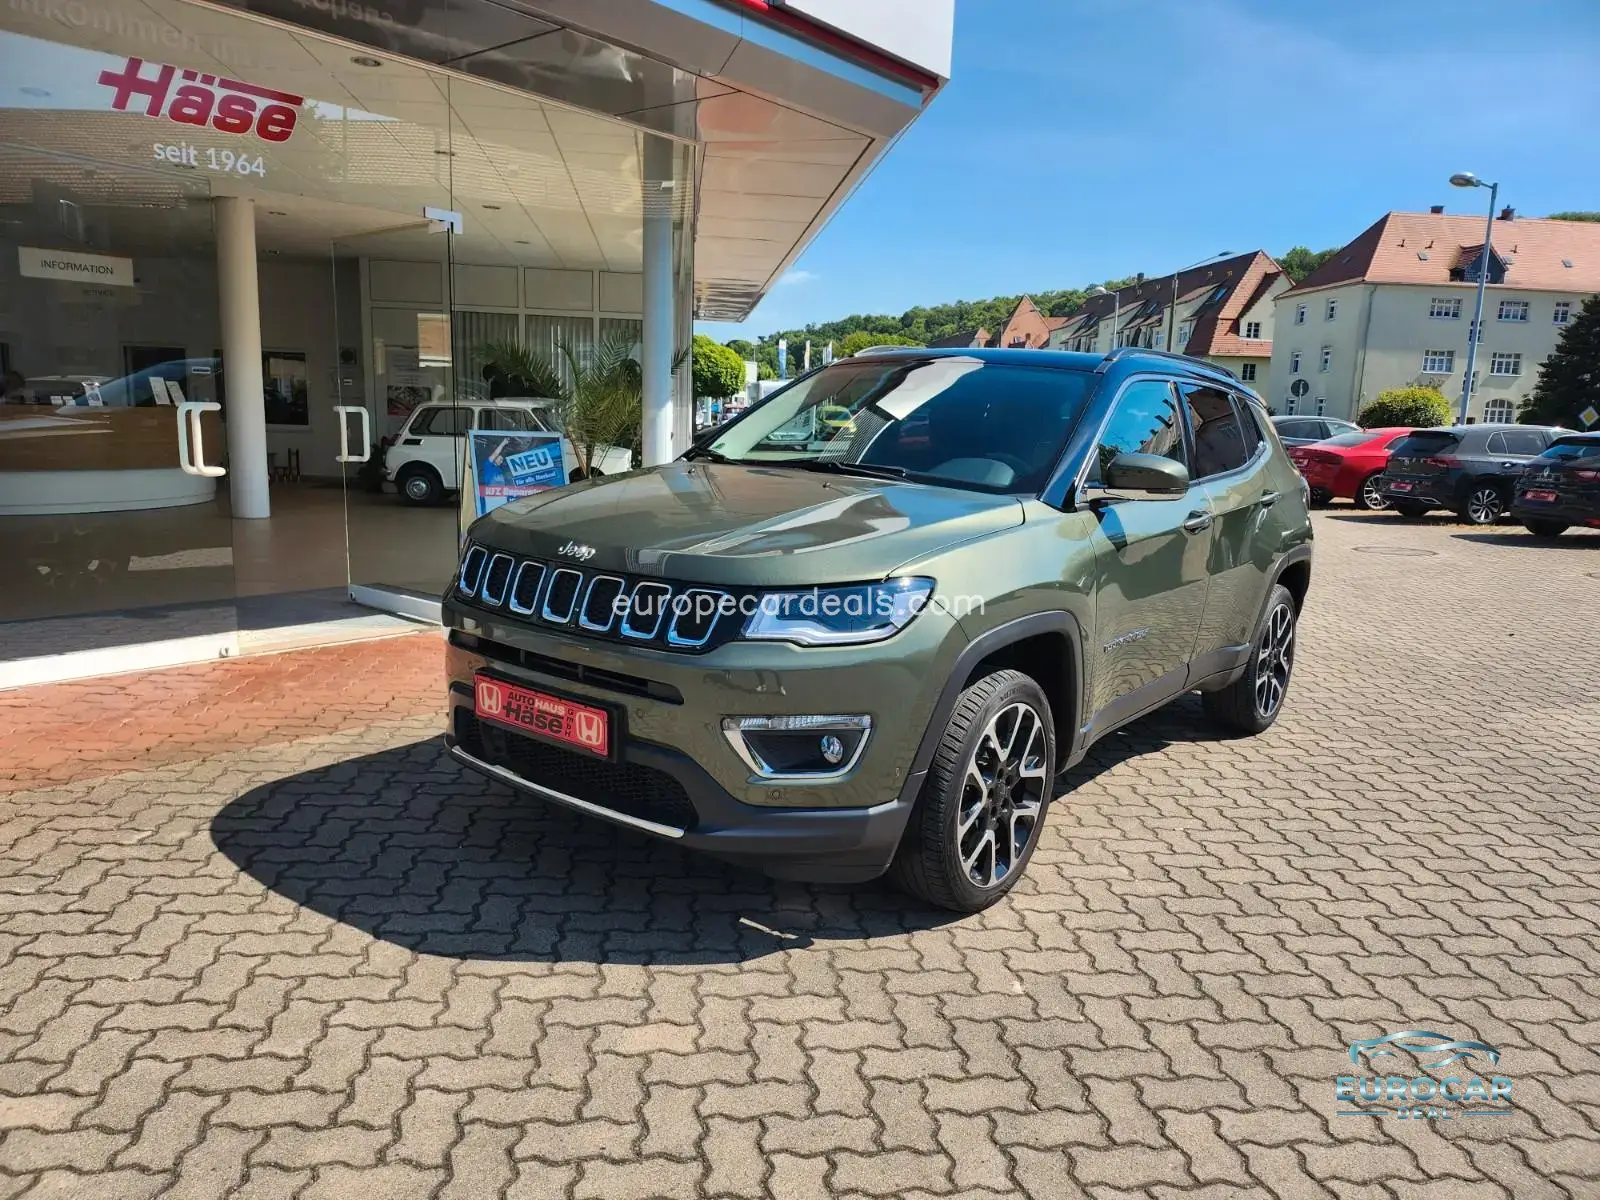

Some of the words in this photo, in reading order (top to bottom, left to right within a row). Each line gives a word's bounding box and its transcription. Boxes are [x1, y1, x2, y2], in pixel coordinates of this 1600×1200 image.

[97, 56, 304, 142] Häse
[153, 140, 198, 167] seit
[206, 147, 265, 178] 1964
[40, 259, 114, 276] INFORMATION
[509, 451, 548, 473] NEU
[558, 541, 596, 561] Jeep
[503, 701, 564, 735] Häse
